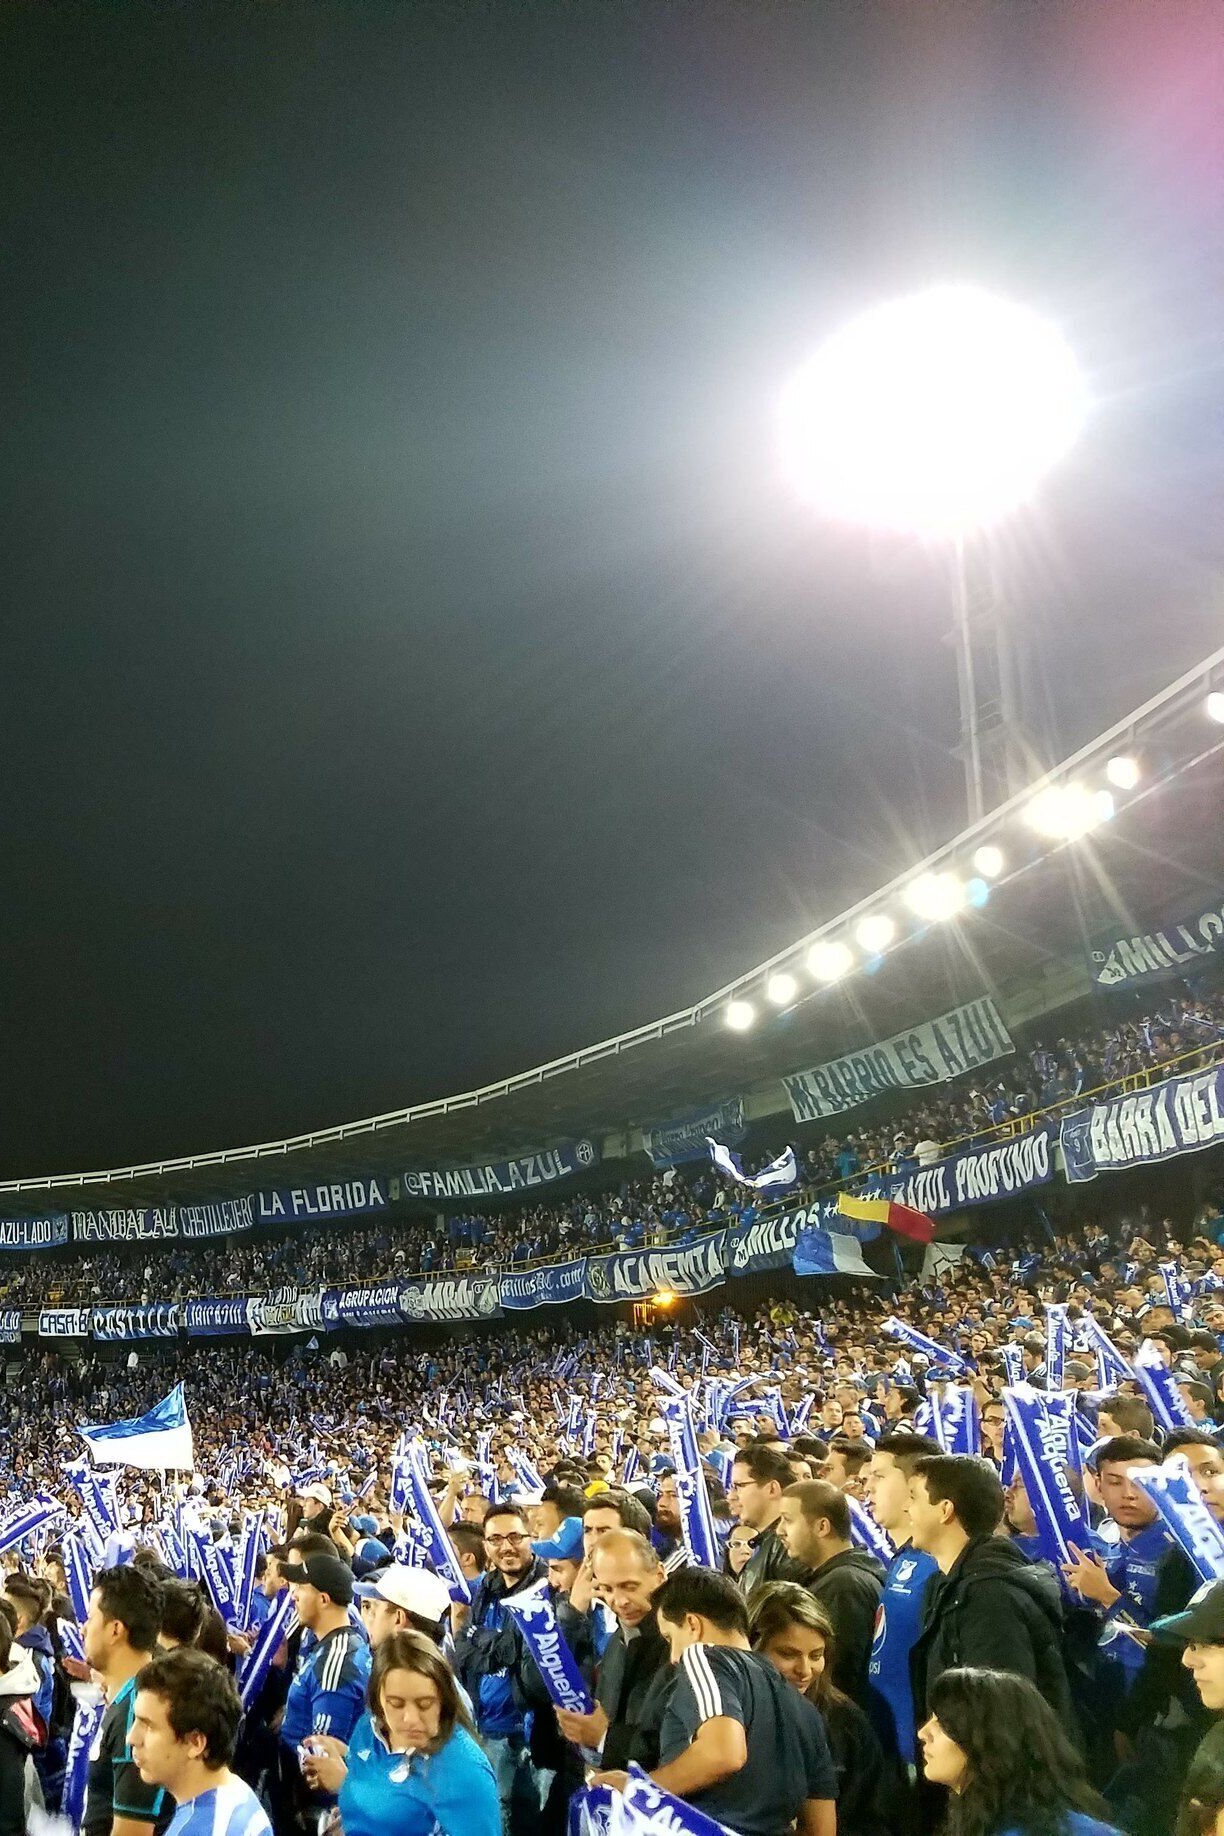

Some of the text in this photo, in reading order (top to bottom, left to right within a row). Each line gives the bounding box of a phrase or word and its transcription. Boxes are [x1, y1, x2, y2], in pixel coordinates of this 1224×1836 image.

[893, 1034, 938, 1083] ES
[931, 999, 1013, 1075] AZUL
[1091, 1071, 1224, 1162] BARRA DEL
[907, 1131, 1048, 1212] AZUL PROFUNDO
[259, 1179, 385, 1216] LA FLORIDA
[0, 1220, 51, 1245] AZU-LADO
[613, 1237, 726, 1293] ACADEMIA
[338, 1286, 400, 1308] AGRUPACION
[93, 1304, 179, 1338] CASTILLA
